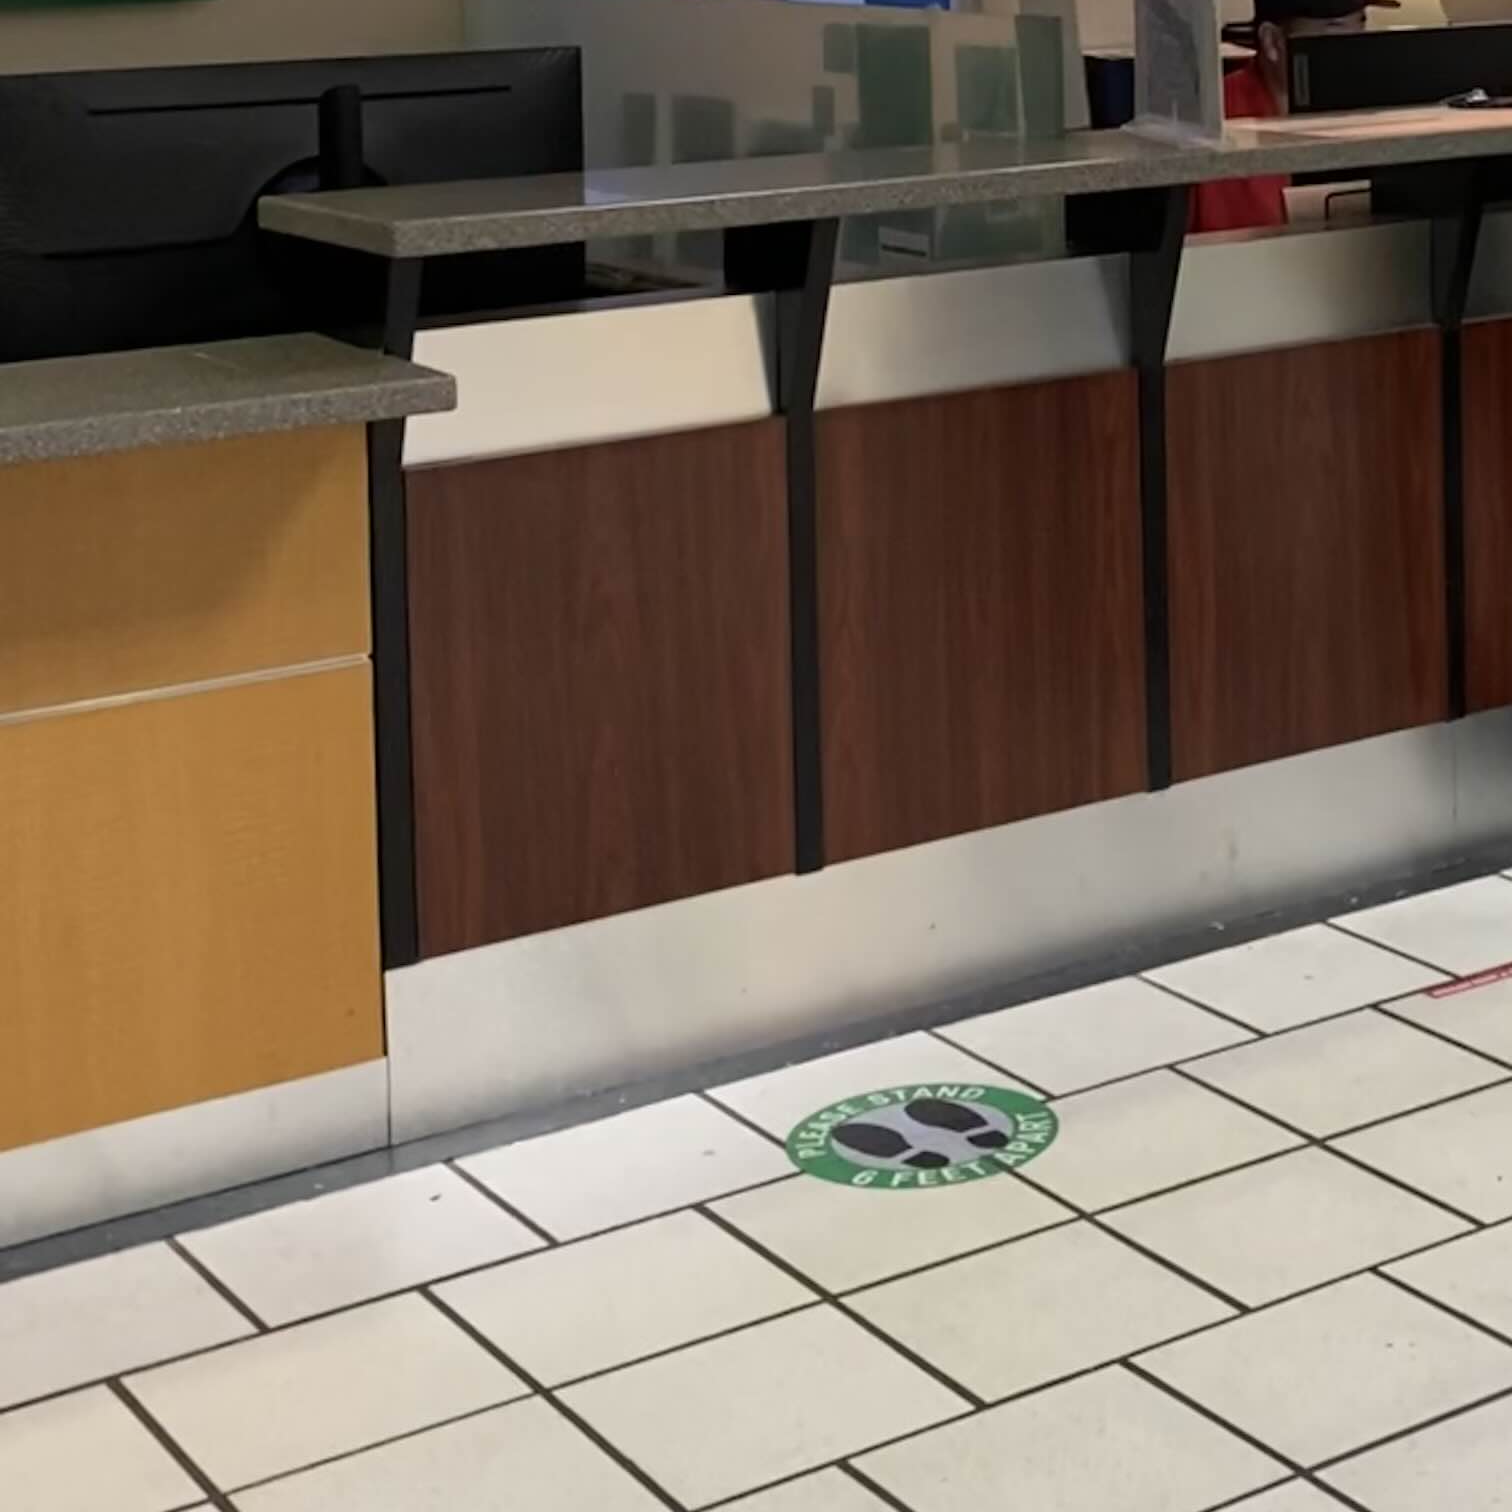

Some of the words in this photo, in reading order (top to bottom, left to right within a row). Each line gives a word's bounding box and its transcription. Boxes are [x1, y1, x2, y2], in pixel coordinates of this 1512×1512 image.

[797, 1103, 864, 1160] PLEASE
[867, 1085, 987, 1106] STAND
[851, 1170, 879, 1186] 6
[889, 1162, 990, 1188] FEET
[993, 1109, 1052, 1166] APART
